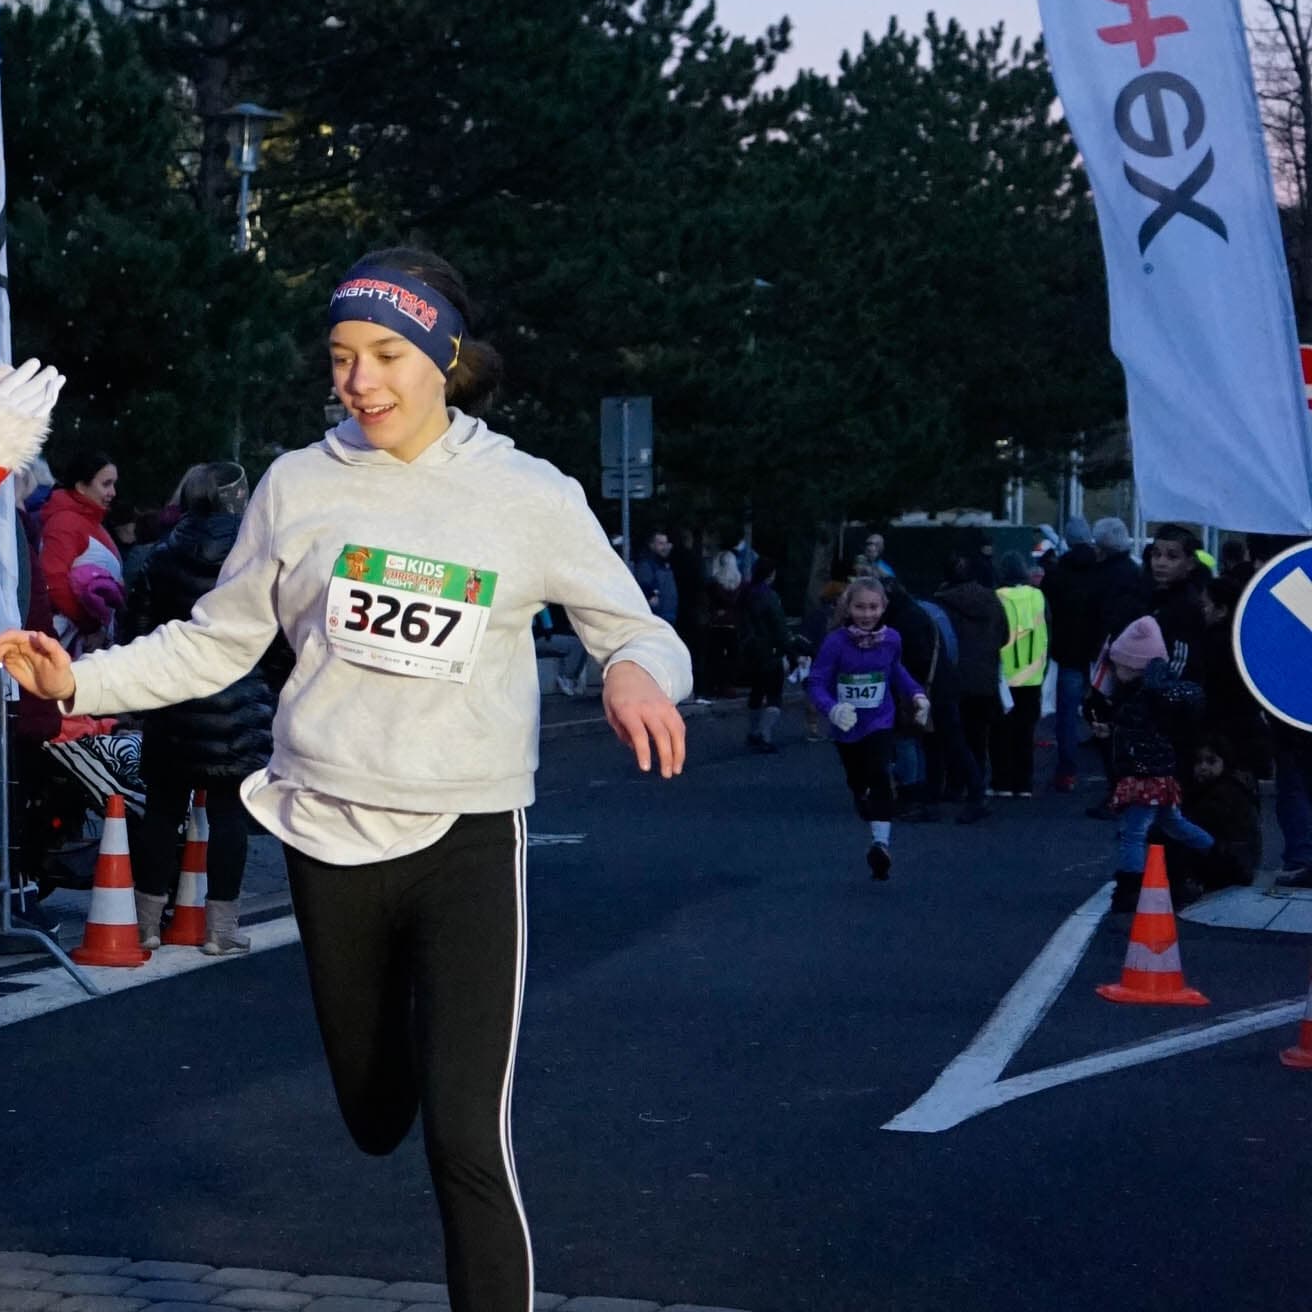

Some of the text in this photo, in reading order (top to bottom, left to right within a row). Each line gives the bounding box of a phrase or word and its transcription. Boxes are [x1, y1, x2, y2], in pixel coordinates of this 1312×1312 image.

[329, 287, 389, 307] NIGHT
[407, 558, 445, 578] KIDS
[344, 589, 462, 648] 3267
[844, 686, 878, 699] 3147
